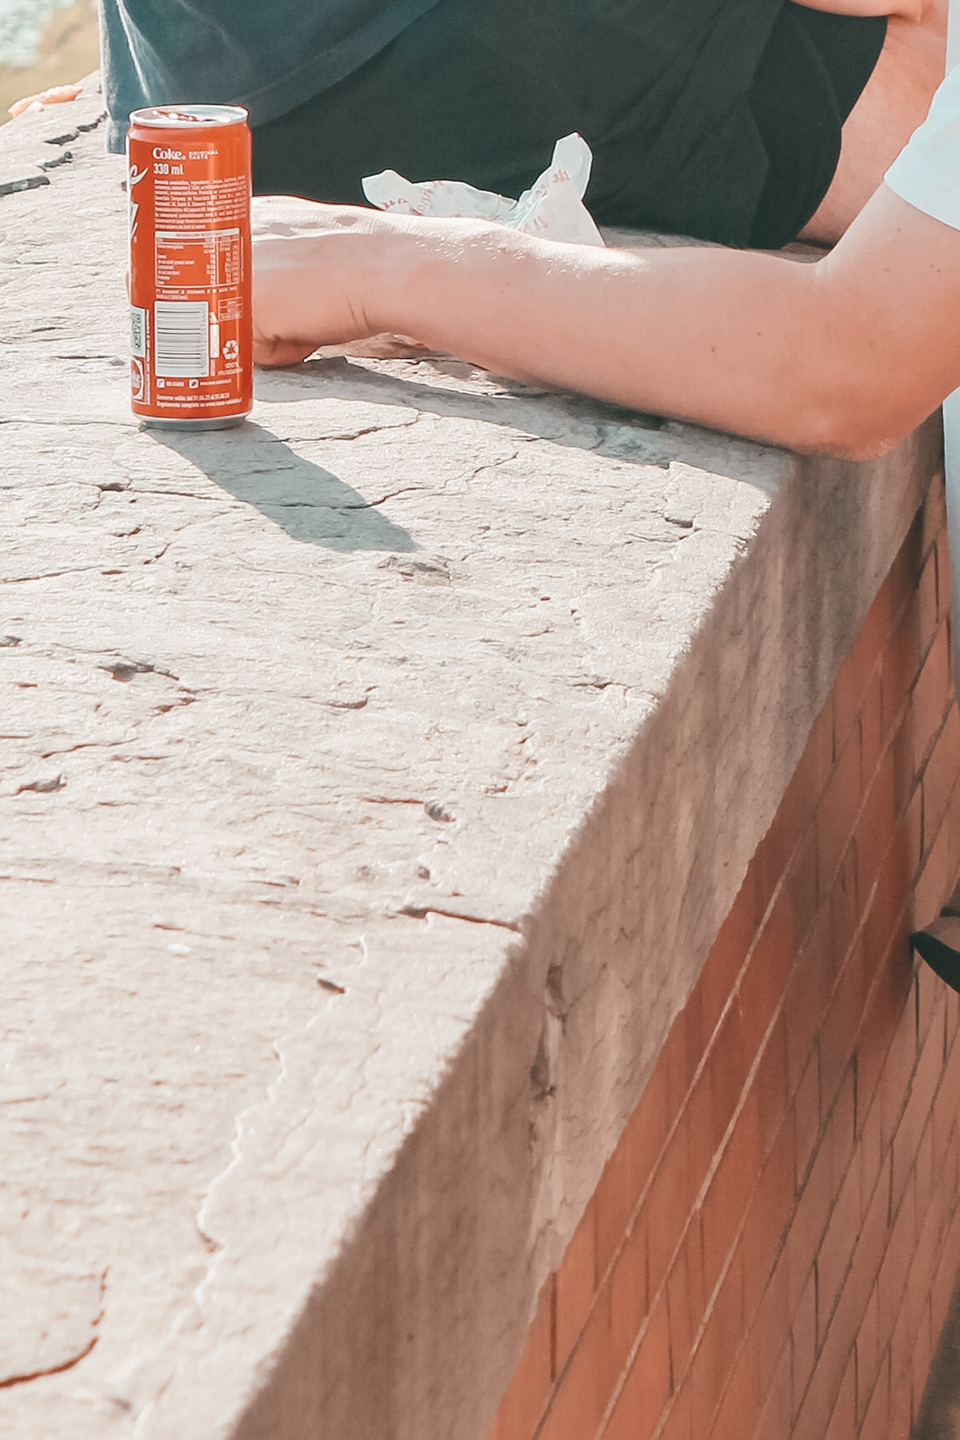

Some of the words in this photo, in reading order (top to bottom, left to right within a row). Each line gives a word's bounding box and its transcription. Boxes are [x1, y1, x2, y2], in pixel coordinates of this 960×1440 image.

[152, 147, 183, 160] Coke
[153, 163, 169, 175] 330
[171, 163, 184, 175] ml
